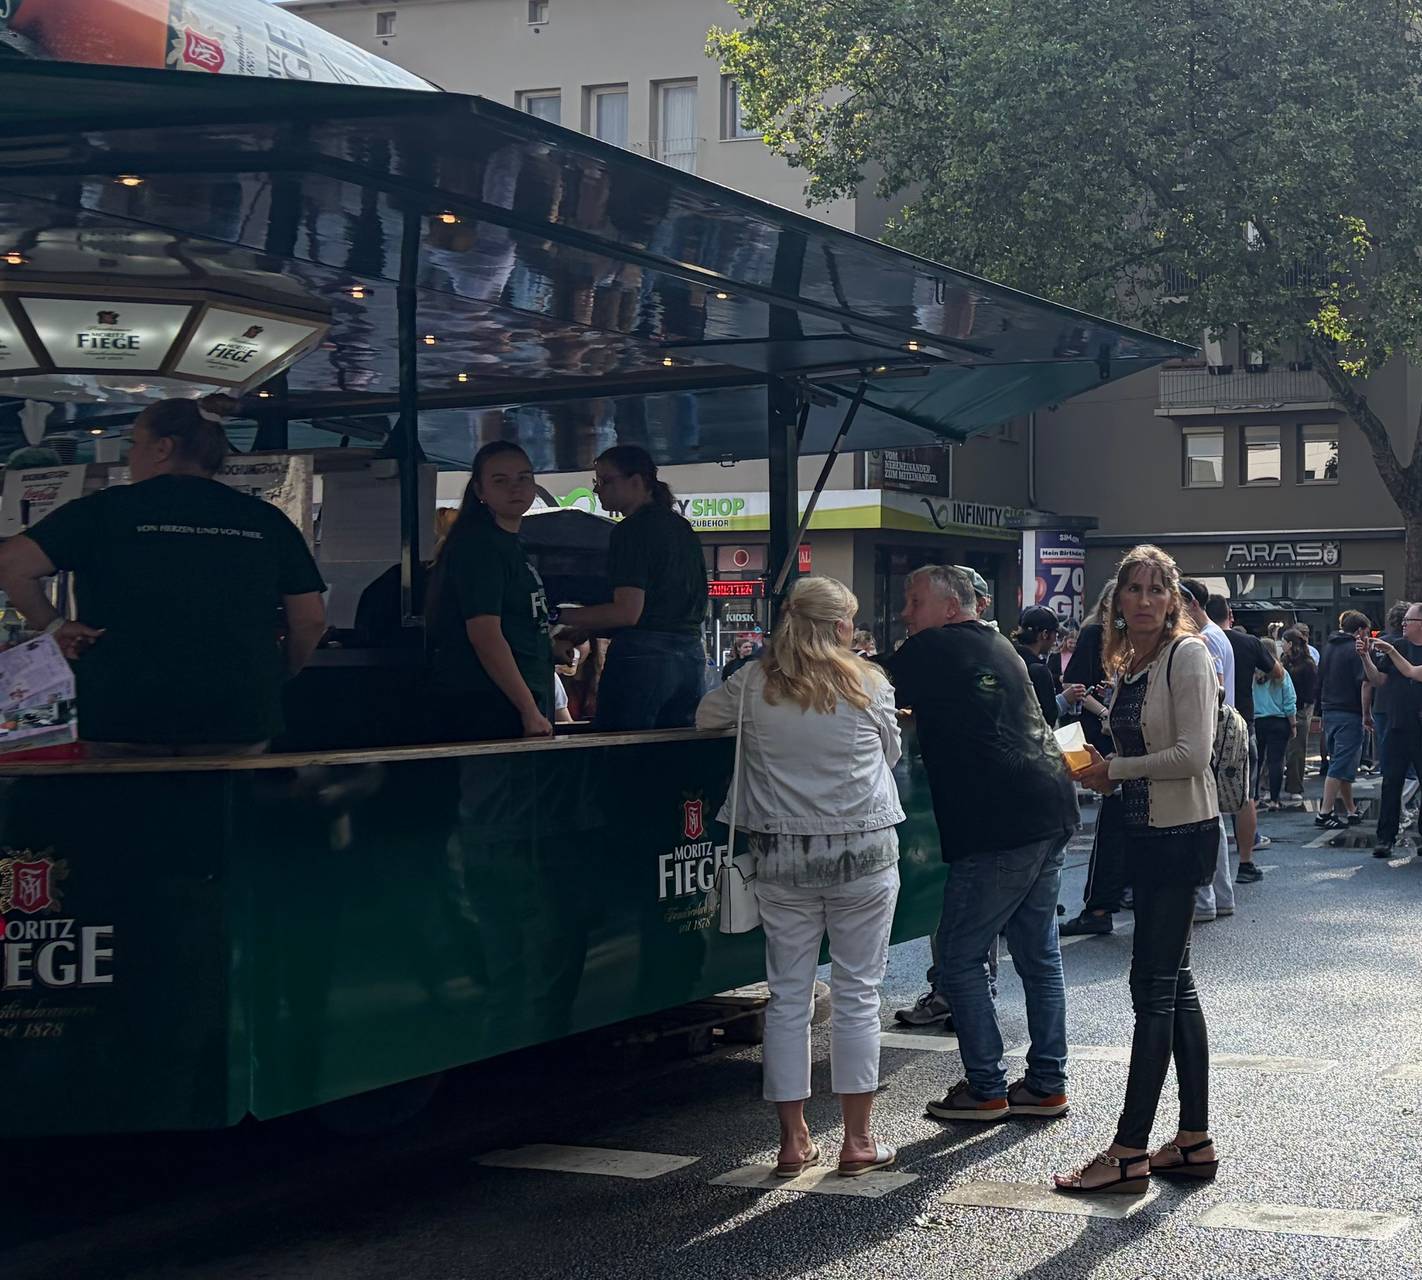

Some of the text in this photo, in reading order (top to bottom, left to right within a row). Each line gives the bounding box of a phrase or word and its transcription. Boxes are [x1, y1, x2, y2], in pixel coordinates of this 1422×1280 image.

[76, 333, 141, 350] FIEGE
[206, 343, 258, 363] FIEGE
[884, 469, 898, 480] ZUM
[692, 498, 745, 517] SHOP
[953, 503, 1002, 527] INFINITY
[220, 528, 240, 536] VON
[1225, 543, 1323, 562] ARAS
[1051, 567, 1085, 593] 70
[726, 613, 755, 622] KIOSK
[674, 841, 713, 861] MORITZ
[0, 918, 76, 941] ORITZ
